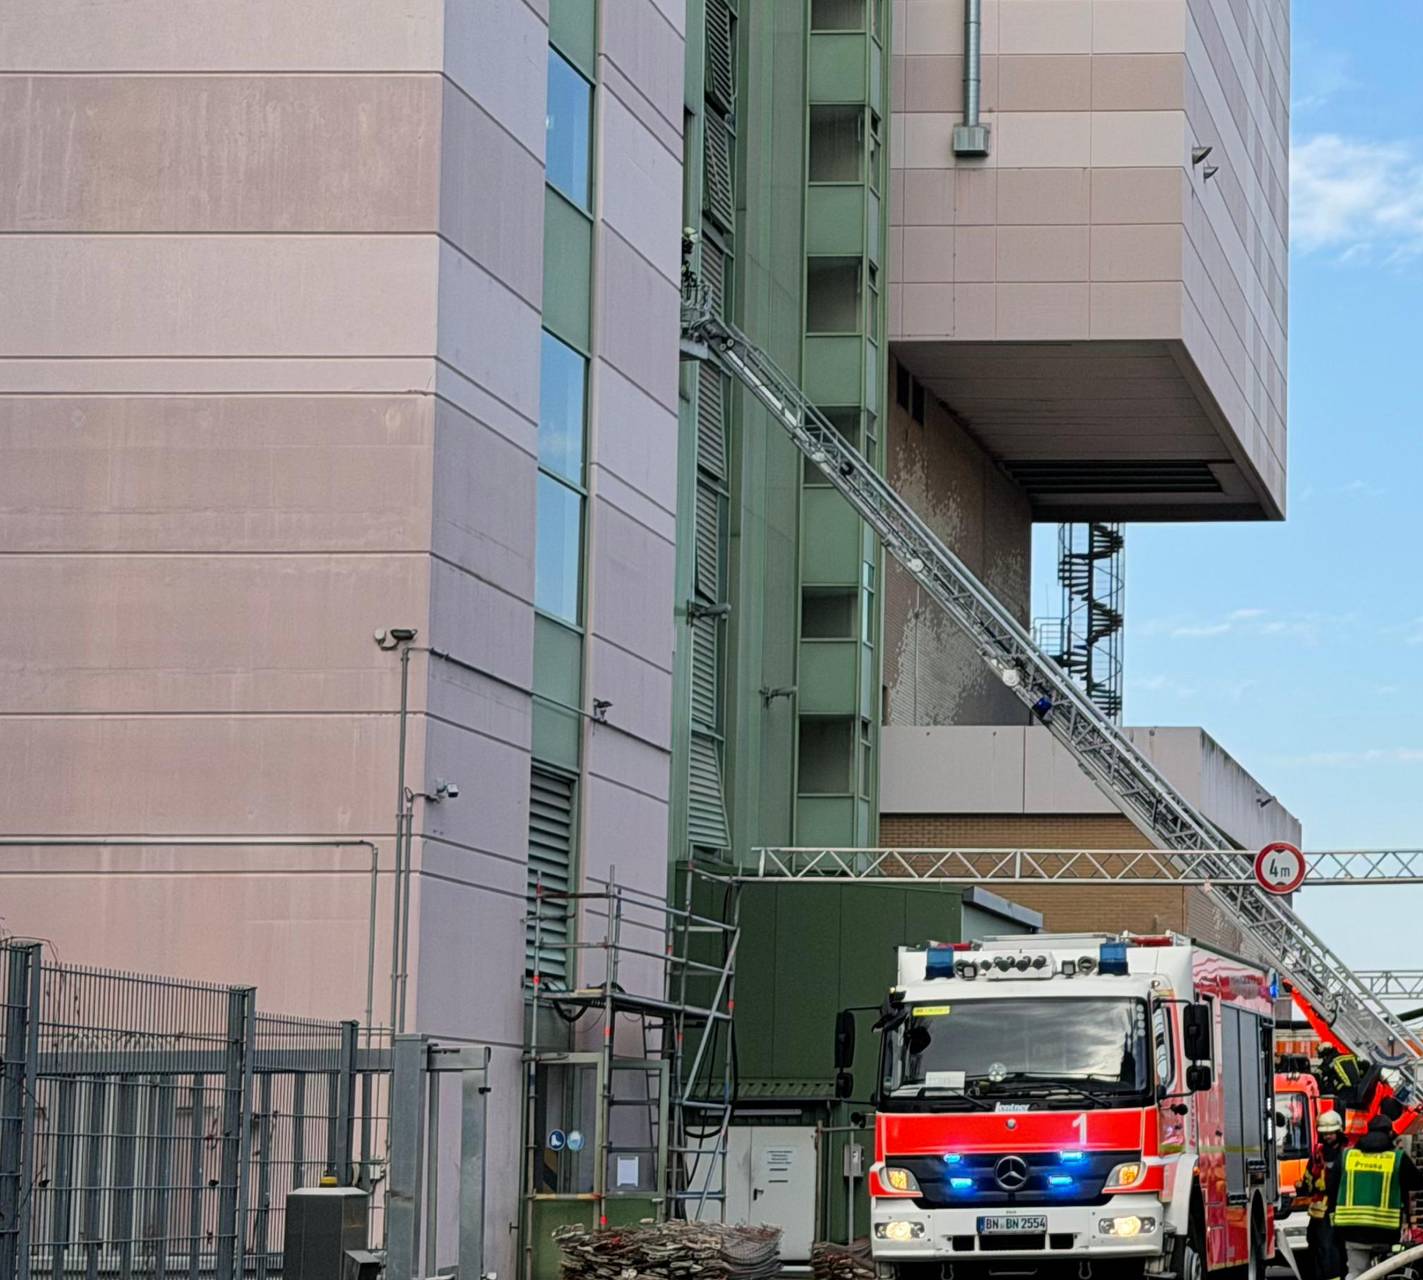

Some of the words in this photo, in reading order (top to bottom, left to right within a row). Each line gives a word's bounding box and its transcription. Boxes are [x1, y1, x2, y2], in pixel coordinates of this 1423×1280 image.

[1269, 858, 1279, 878] 4
[1280, 866, 1291, 878] m
[1072, 1112, 1088, 1145] 1
[986, 1218, 999, 1230] BN
[1005, 1218, 1019, 1229] BN
[1021, 1217, 1046, 1229] 2554
